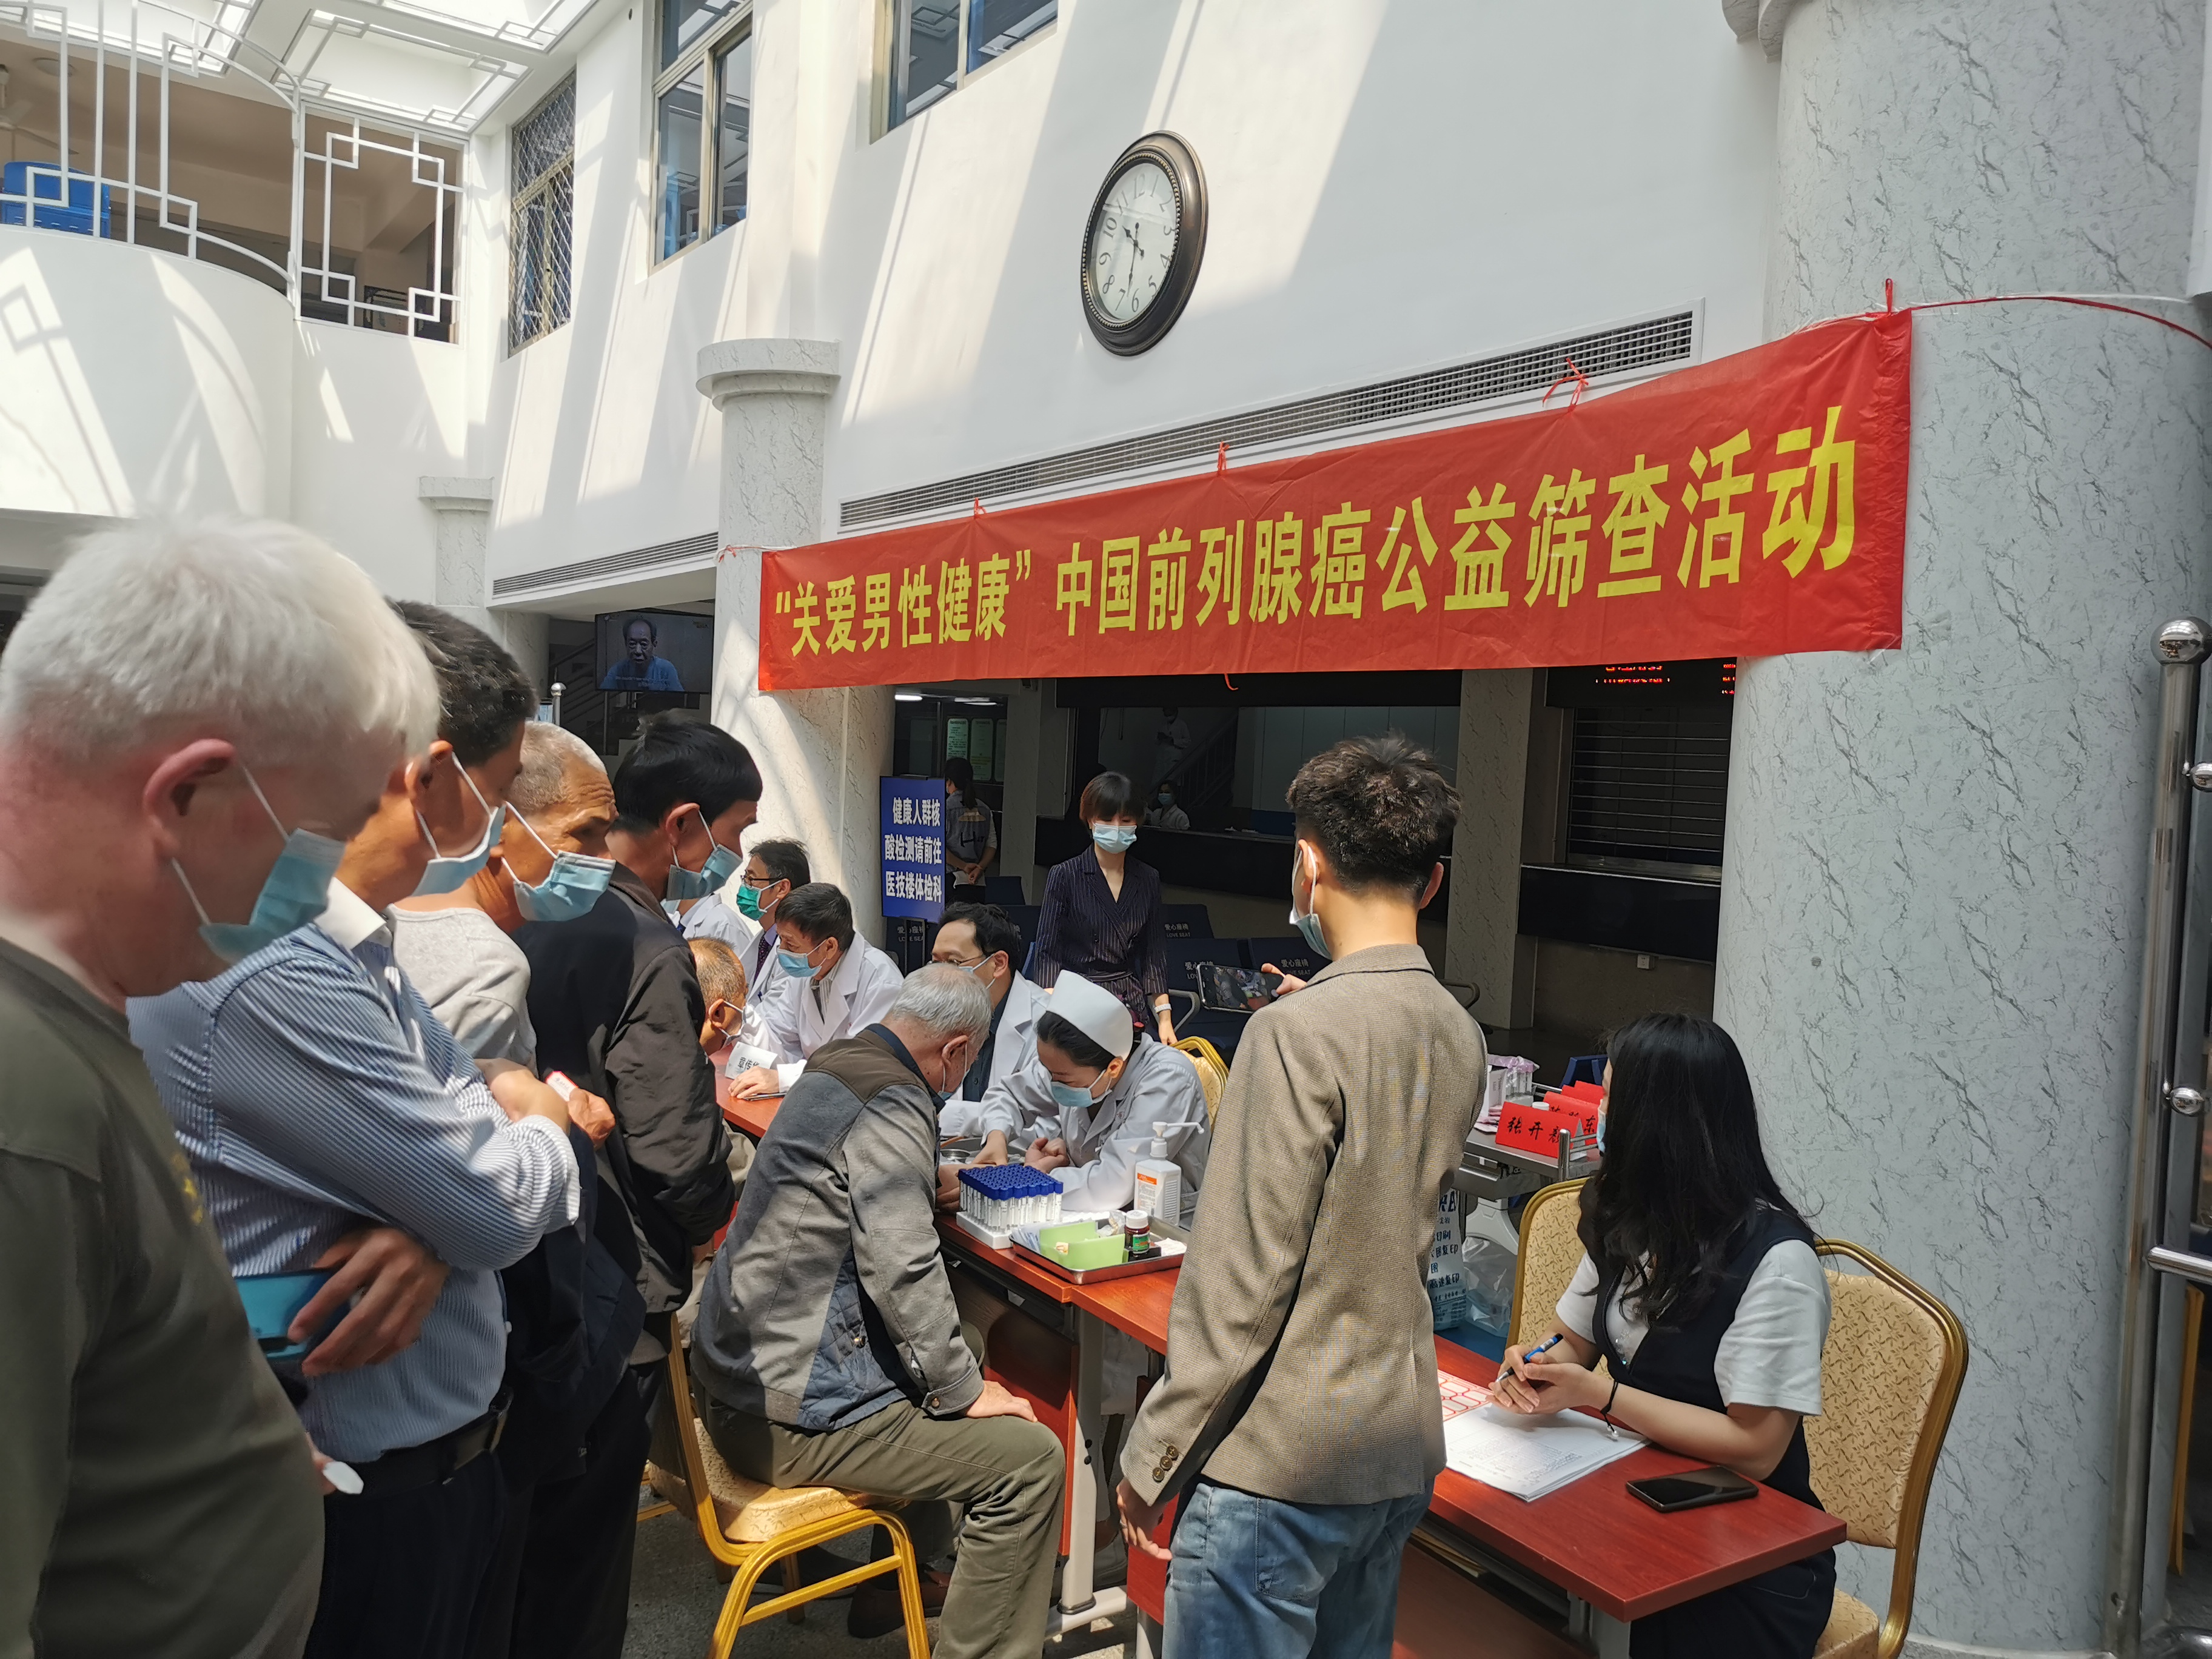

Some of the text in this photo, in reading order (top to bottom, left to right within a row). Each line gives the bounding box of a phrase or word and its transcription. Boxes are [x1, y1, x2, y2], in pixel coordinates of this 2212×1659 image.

[1104, 217, 1117, 239] 10
[1099, 252, 1111, 266] 9
[1160, 253, 1172, 269] 4
[1102, 274, 1115, 294] 8
[1115, 289, 1125, 311] 7
[1132, 288, 1139, 312] 6
[1056, 405, 1855, 636] 中国前列腺癌公益筛查活动
[893, 797, 940, 827] 健康人群核
[885, 834, 942, 865] 酸检测请前往
[885, 871, 942, 903] 医技楼体检科
